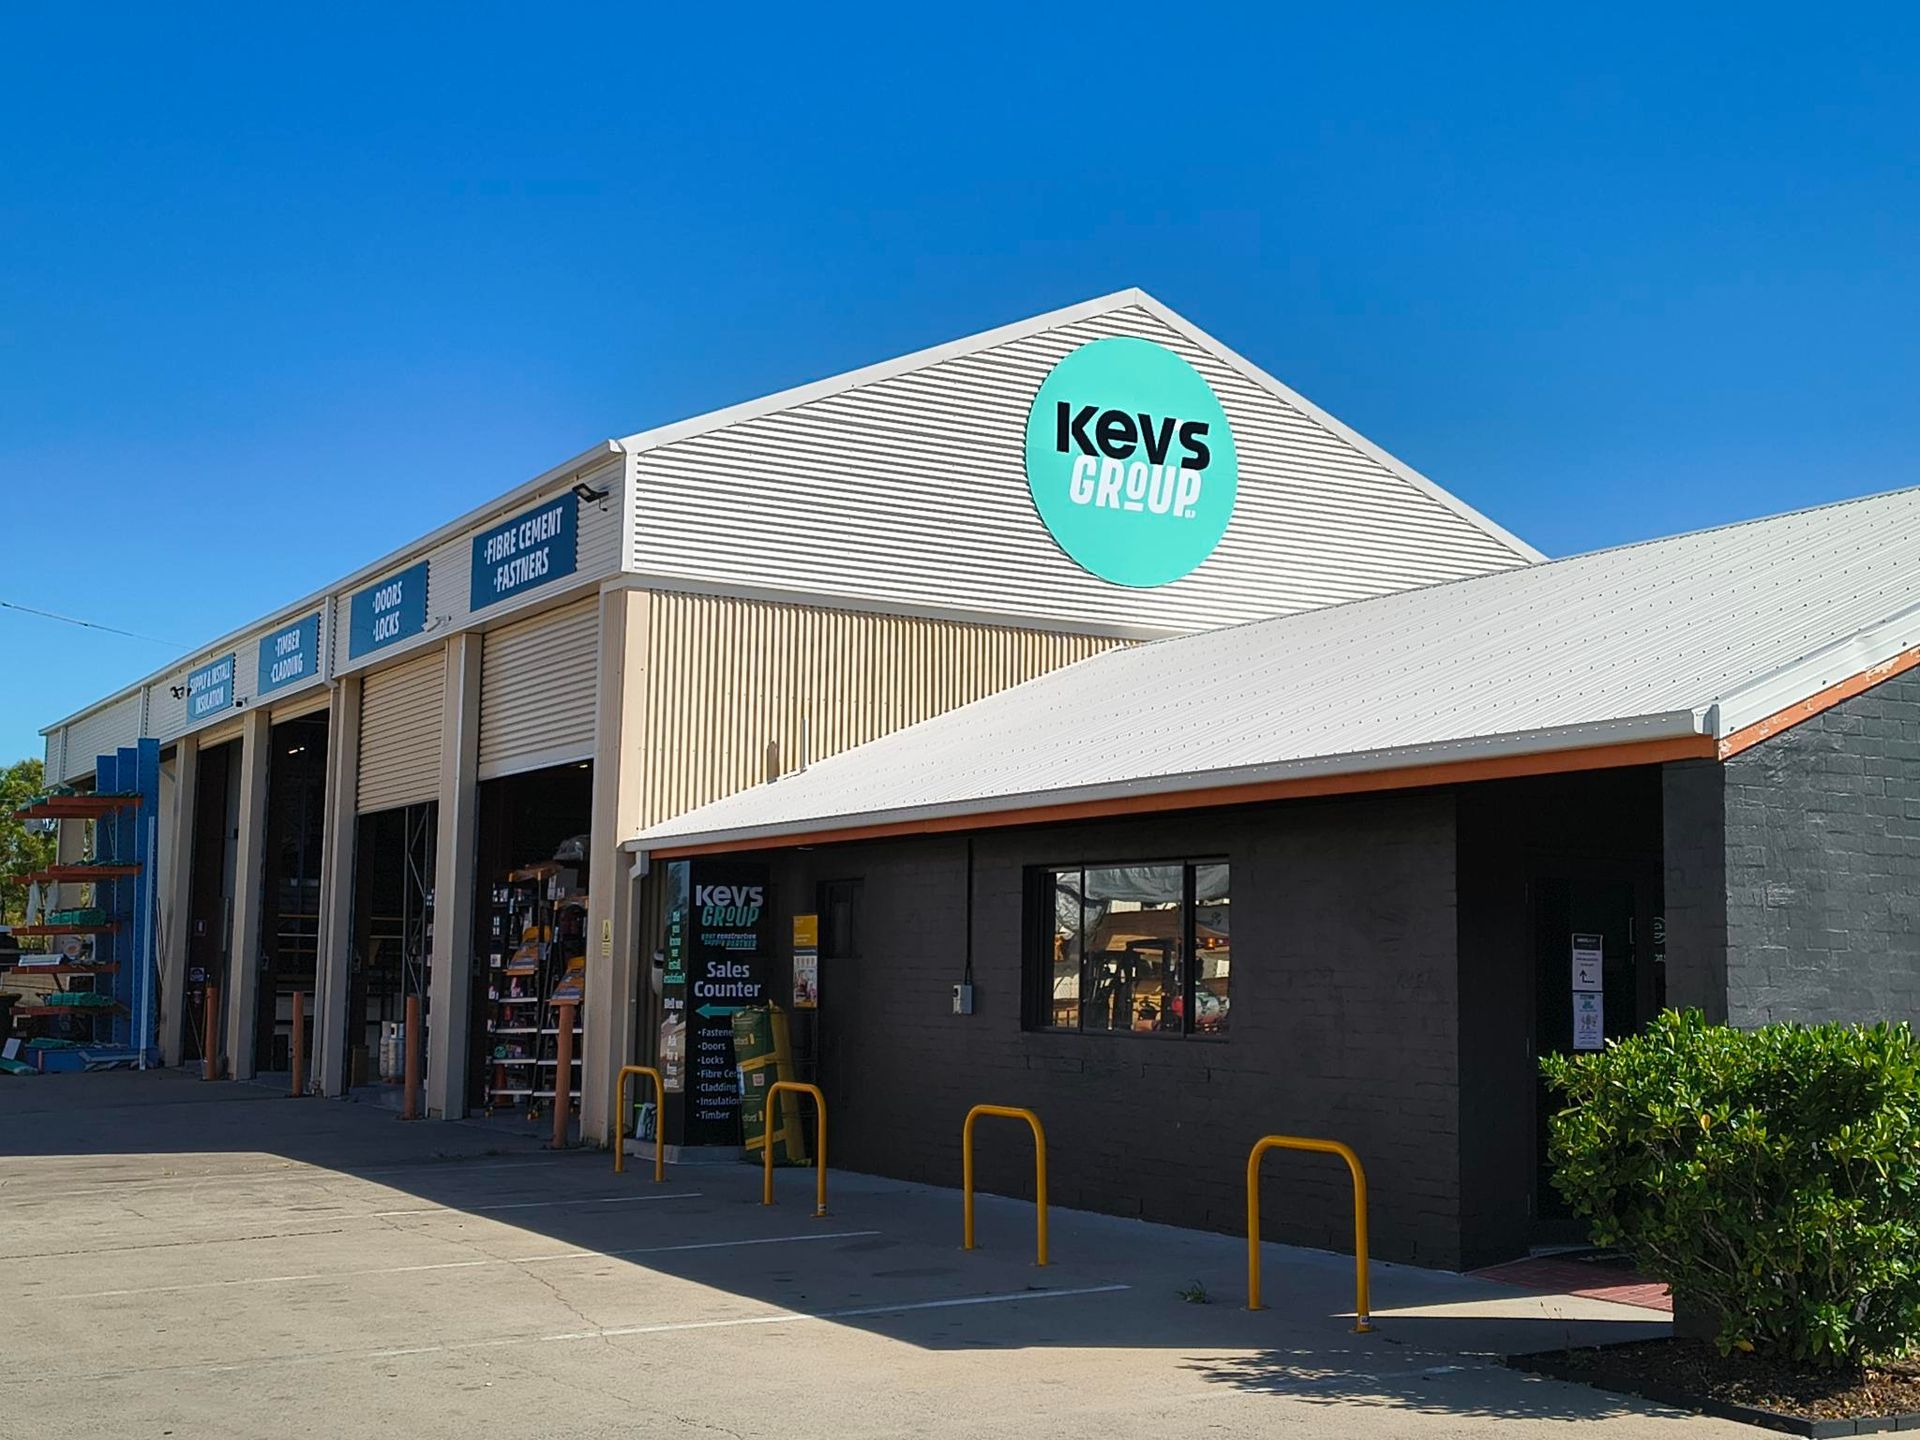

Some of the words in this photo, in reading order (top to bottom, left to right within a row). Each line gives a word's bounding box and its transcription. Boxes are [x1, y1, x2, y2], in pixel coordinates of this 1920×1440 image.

[486, 528, 517, 565] FIBRE
[518, 506, 564, 550] CEMENT
[496, 547, 550, 593] FASTNERS
[374, 581, 403, 614] DOORS
[375, 611, 400, 642] LOCKS
[277, 629, 301, 657] TIMBER
[189, 672, 207, 695] SUPPLY
[211, 661, 231, 685] INSTALL
[272, 653, 303, 683] CLADDING
[195, 686, 224, 714] INSULATION
[701, 906, 760, 927] GROUP
[706, 961, 750, 978] Sales
[693, 981, 762, 997] Counter
[700, 1070, 722, 1078] Fibre
[700, 1083, 737, 1094] Cladding
[700, 1111, 730, 1120] Timber
